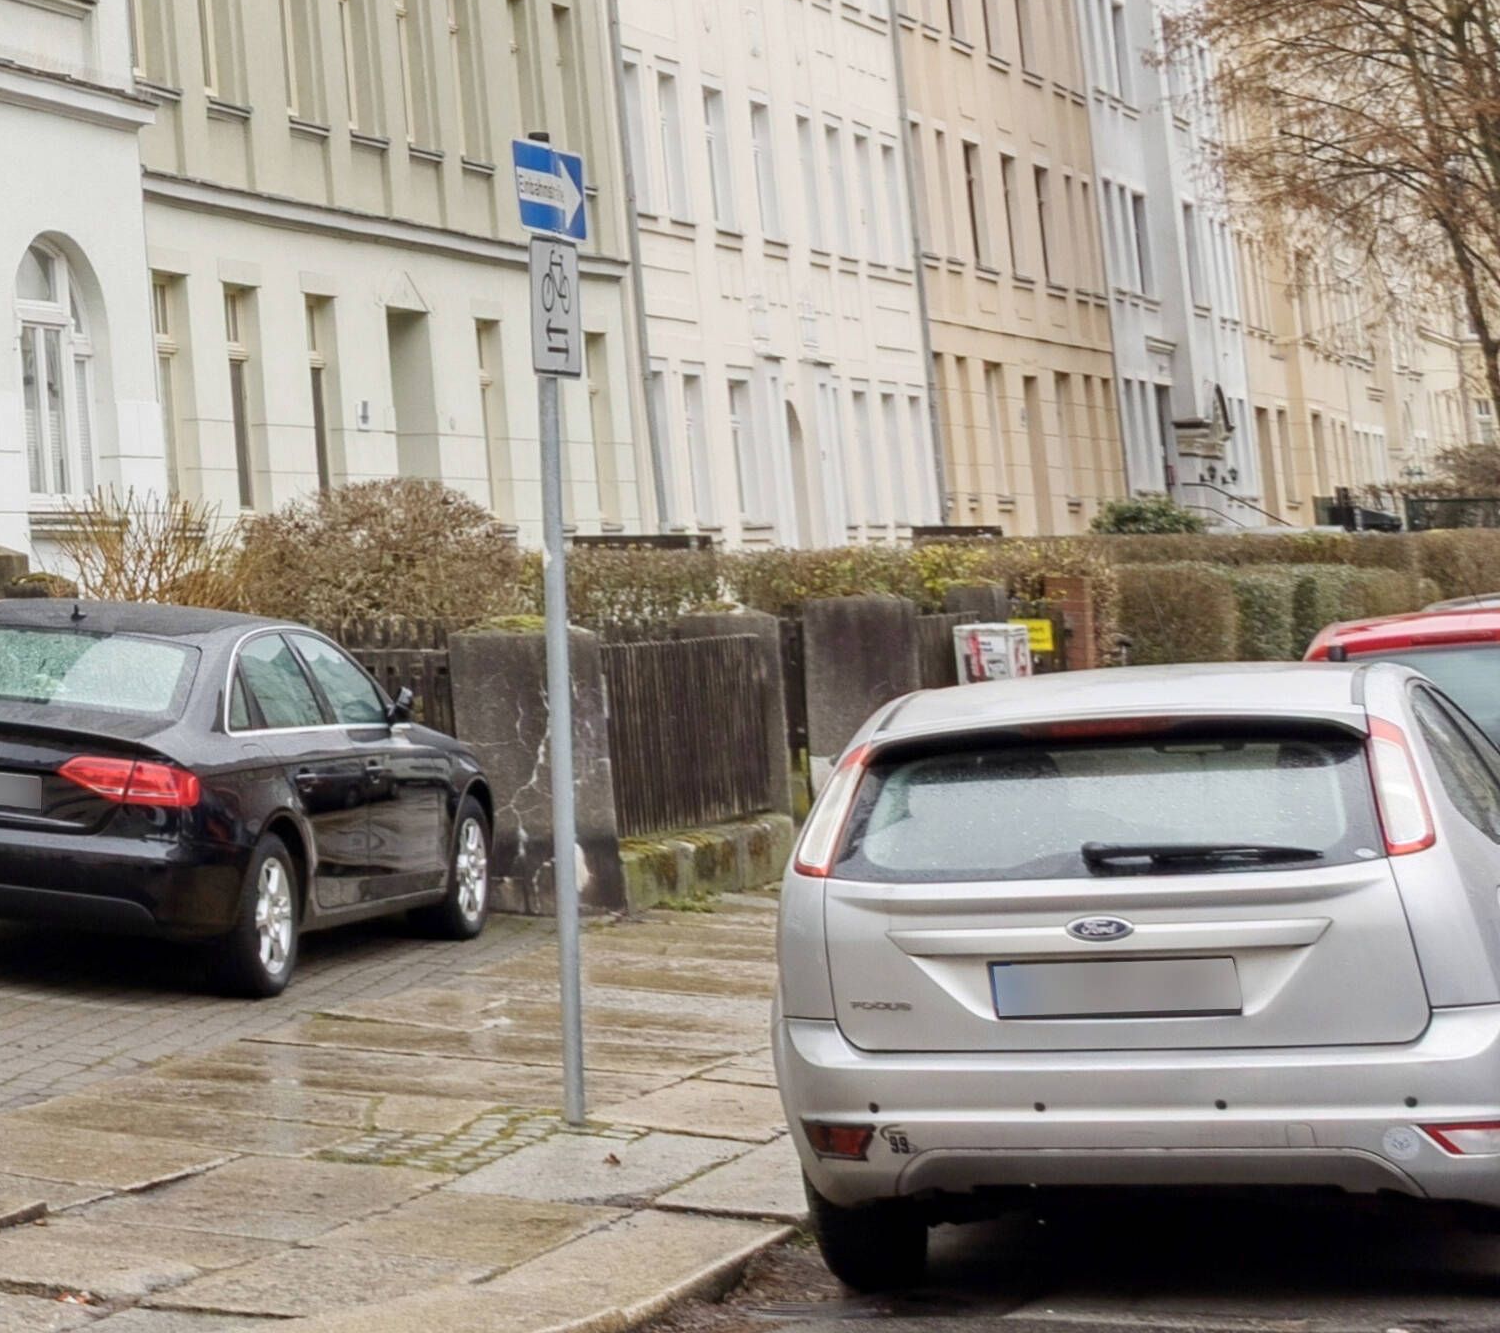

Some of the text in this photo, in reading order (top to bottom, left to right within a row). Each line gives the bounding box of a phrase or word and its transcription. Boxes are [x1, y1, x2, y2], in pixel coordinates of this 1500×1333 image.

[1080, 920, 1117, 935] Ford
[850, 1001, 912, 1011] FOCUS
[889, 1135, 910, 1154] 99
